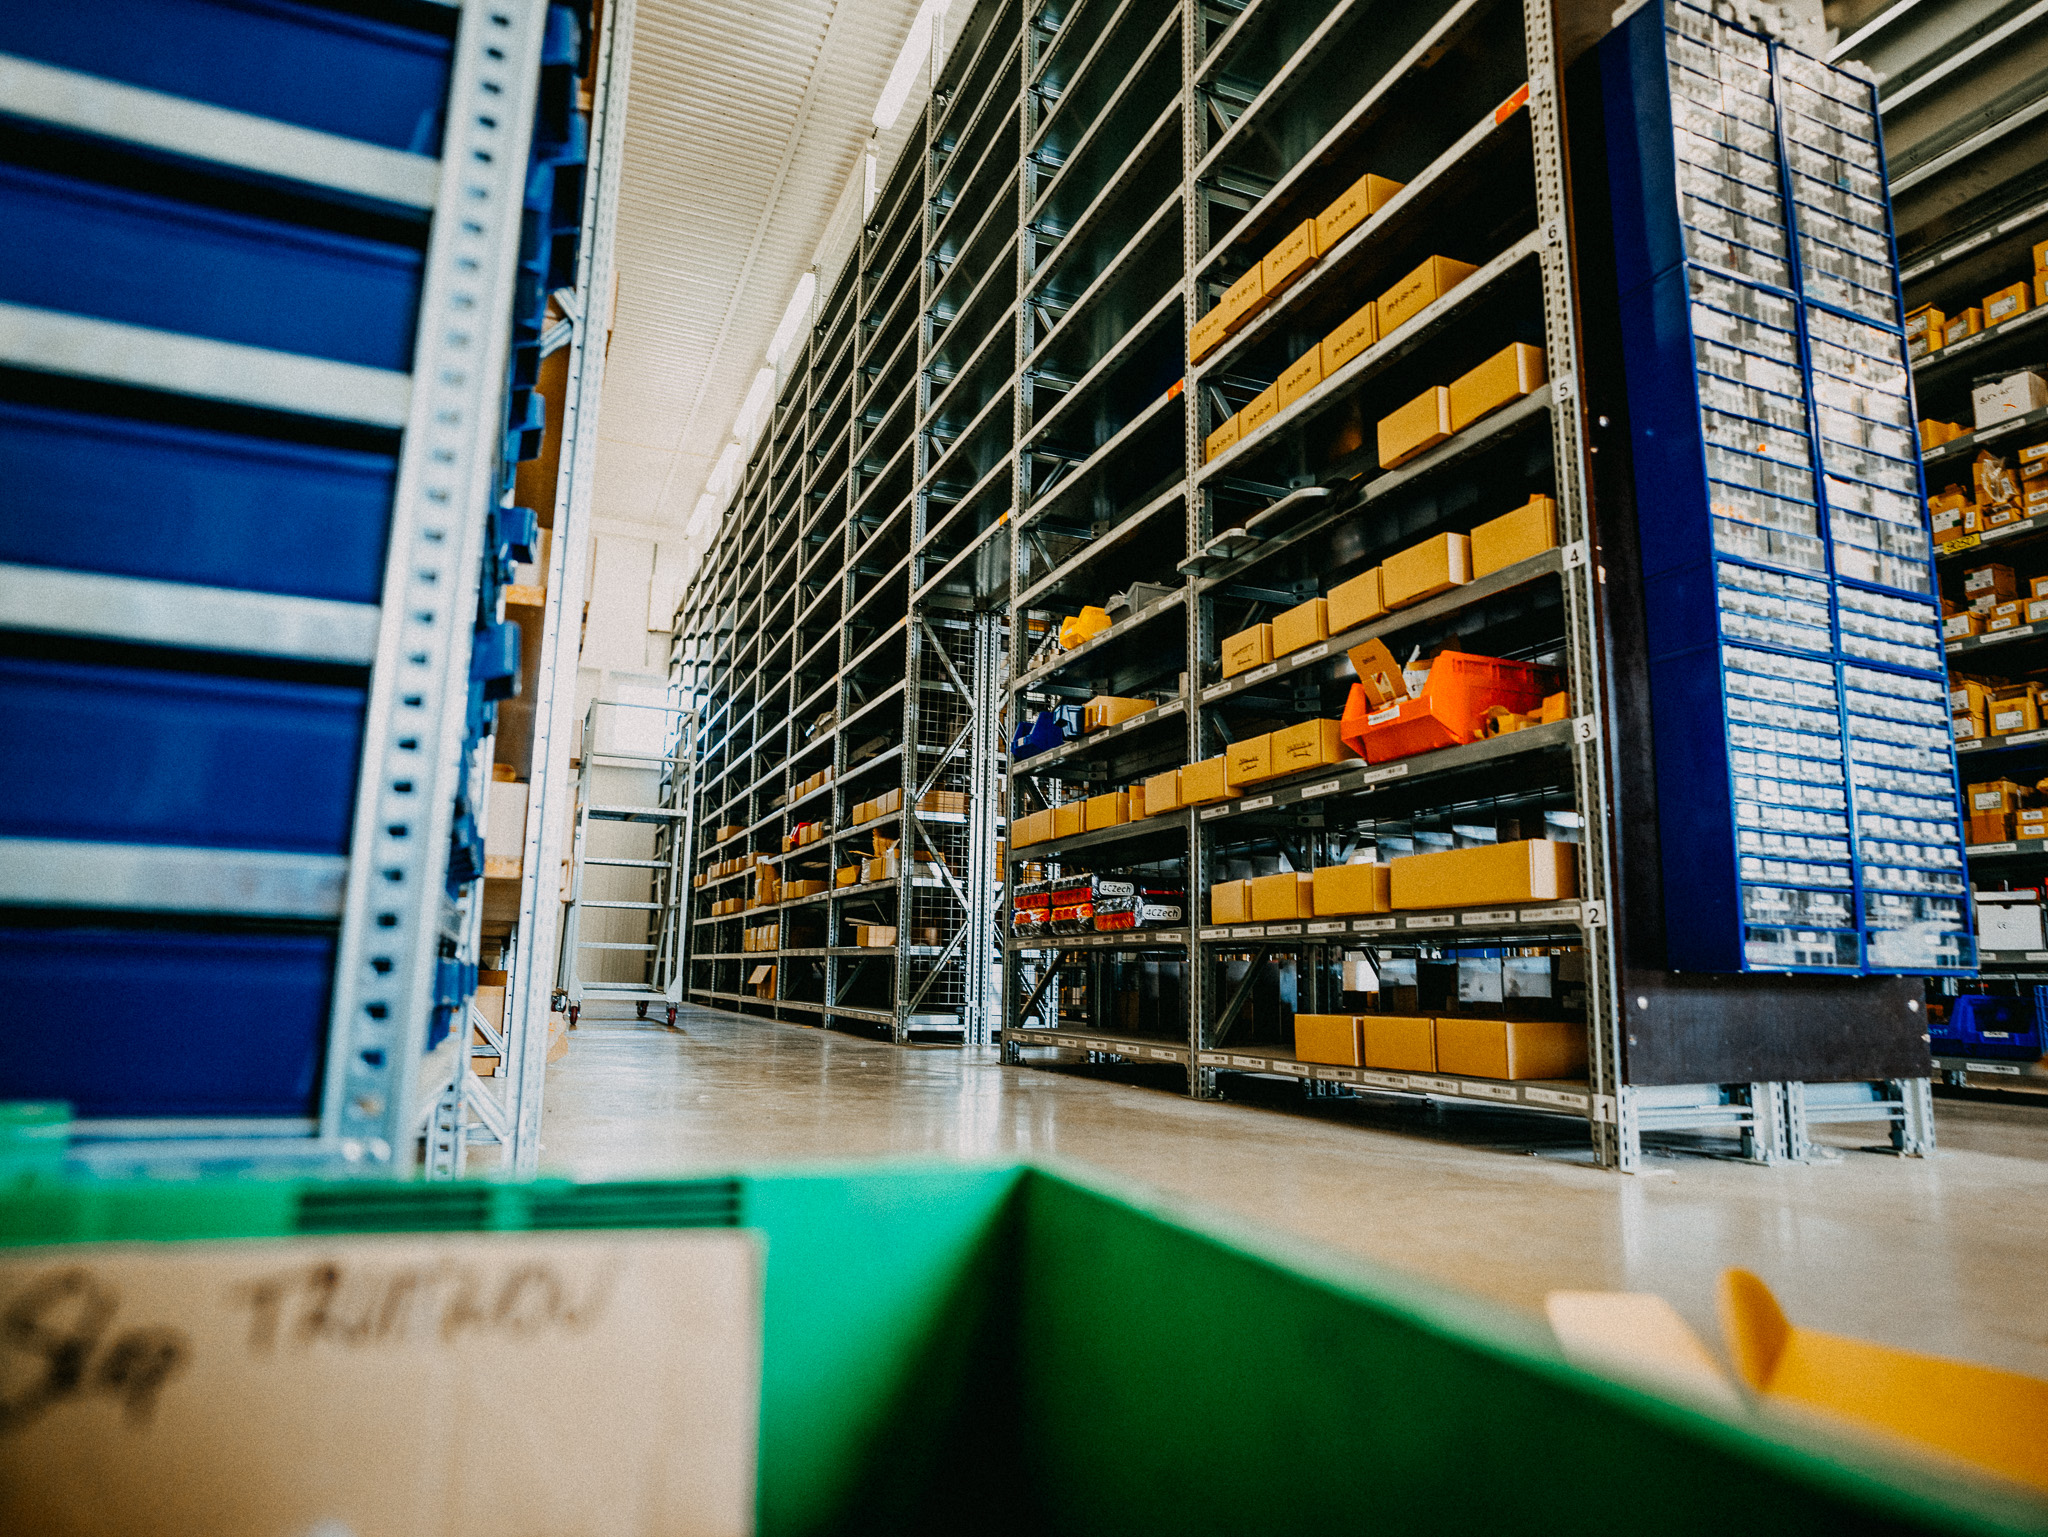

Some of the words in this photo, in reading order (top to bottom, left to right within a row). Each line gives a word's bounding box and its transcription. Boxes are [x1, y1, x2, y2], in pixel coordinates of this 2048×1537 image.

[1548, 224, 1557, 239] 6
[1559, 381, 1568, 397] 5
[1570, 548, 1579, 563] 4
[1580, 722, 1591, 738] 3
[1101, 884, 1132, 893] 4CZech
[1145, 908, 1179, 918] 4CZech
[1588, 907, 1600, 924] 2
[1601, 1102, 1609, 1120] 1
